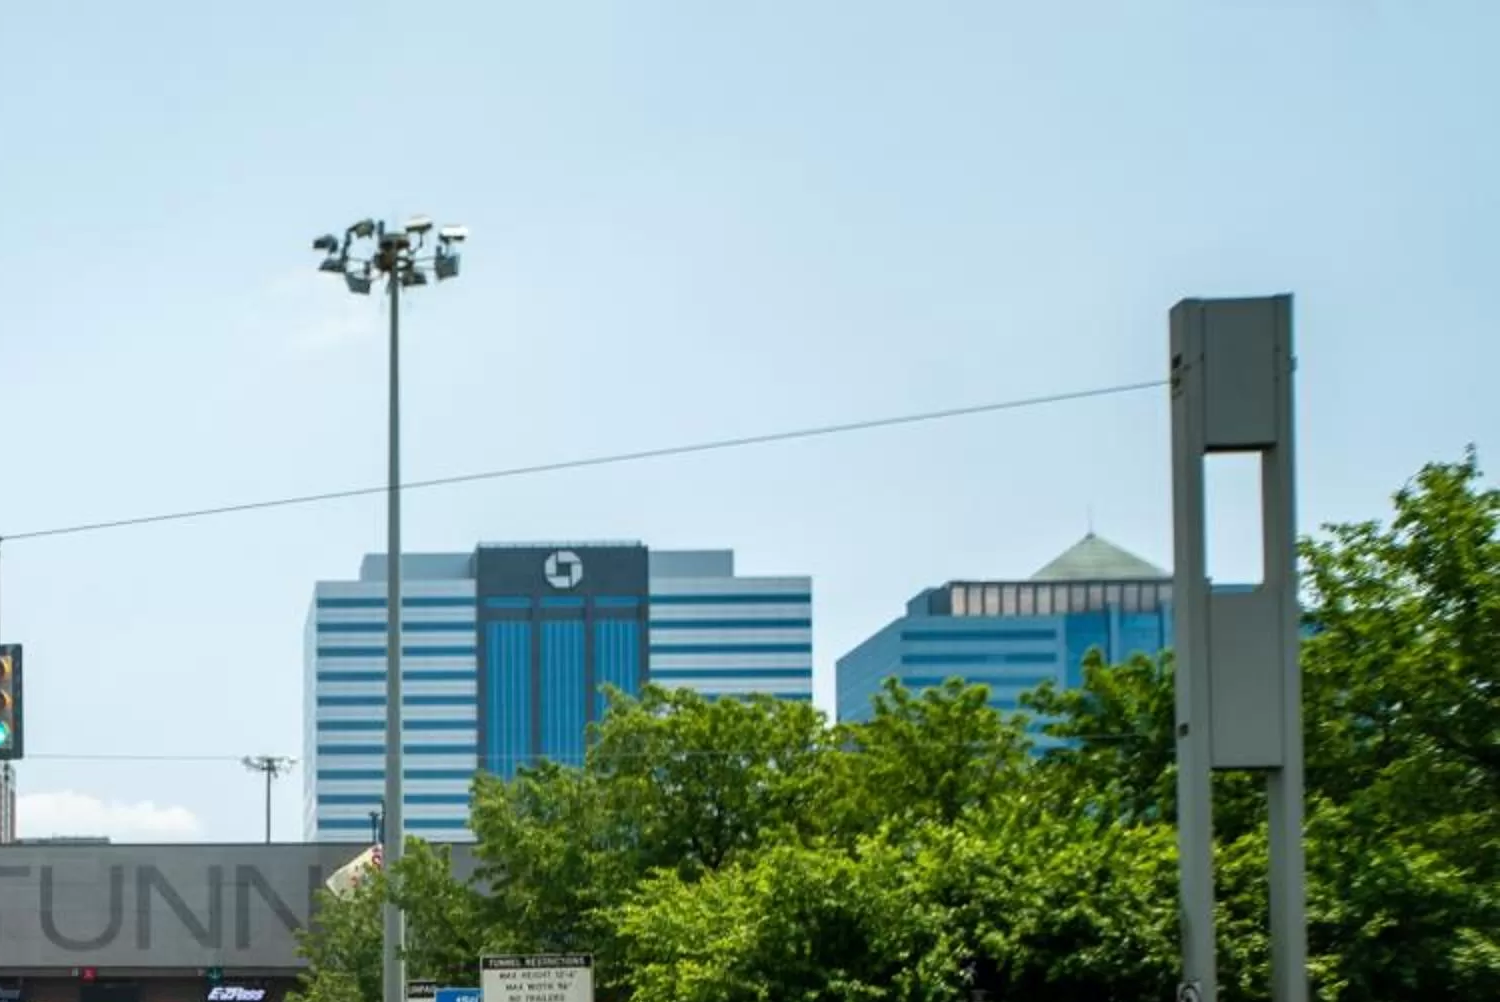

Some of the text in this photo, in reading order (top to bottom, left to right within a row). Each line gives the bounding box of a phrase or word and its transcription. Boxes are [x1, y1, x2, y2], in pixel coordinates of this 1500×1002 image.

[499, 971, 517, 979] MAX
[522, 971, 551, 979] HEIGHT
[505, 983, 523, 991] MAX
[527, 983, 554, 991] WIDTH
[508, 994, 565, 1002] NO TRAILERS
